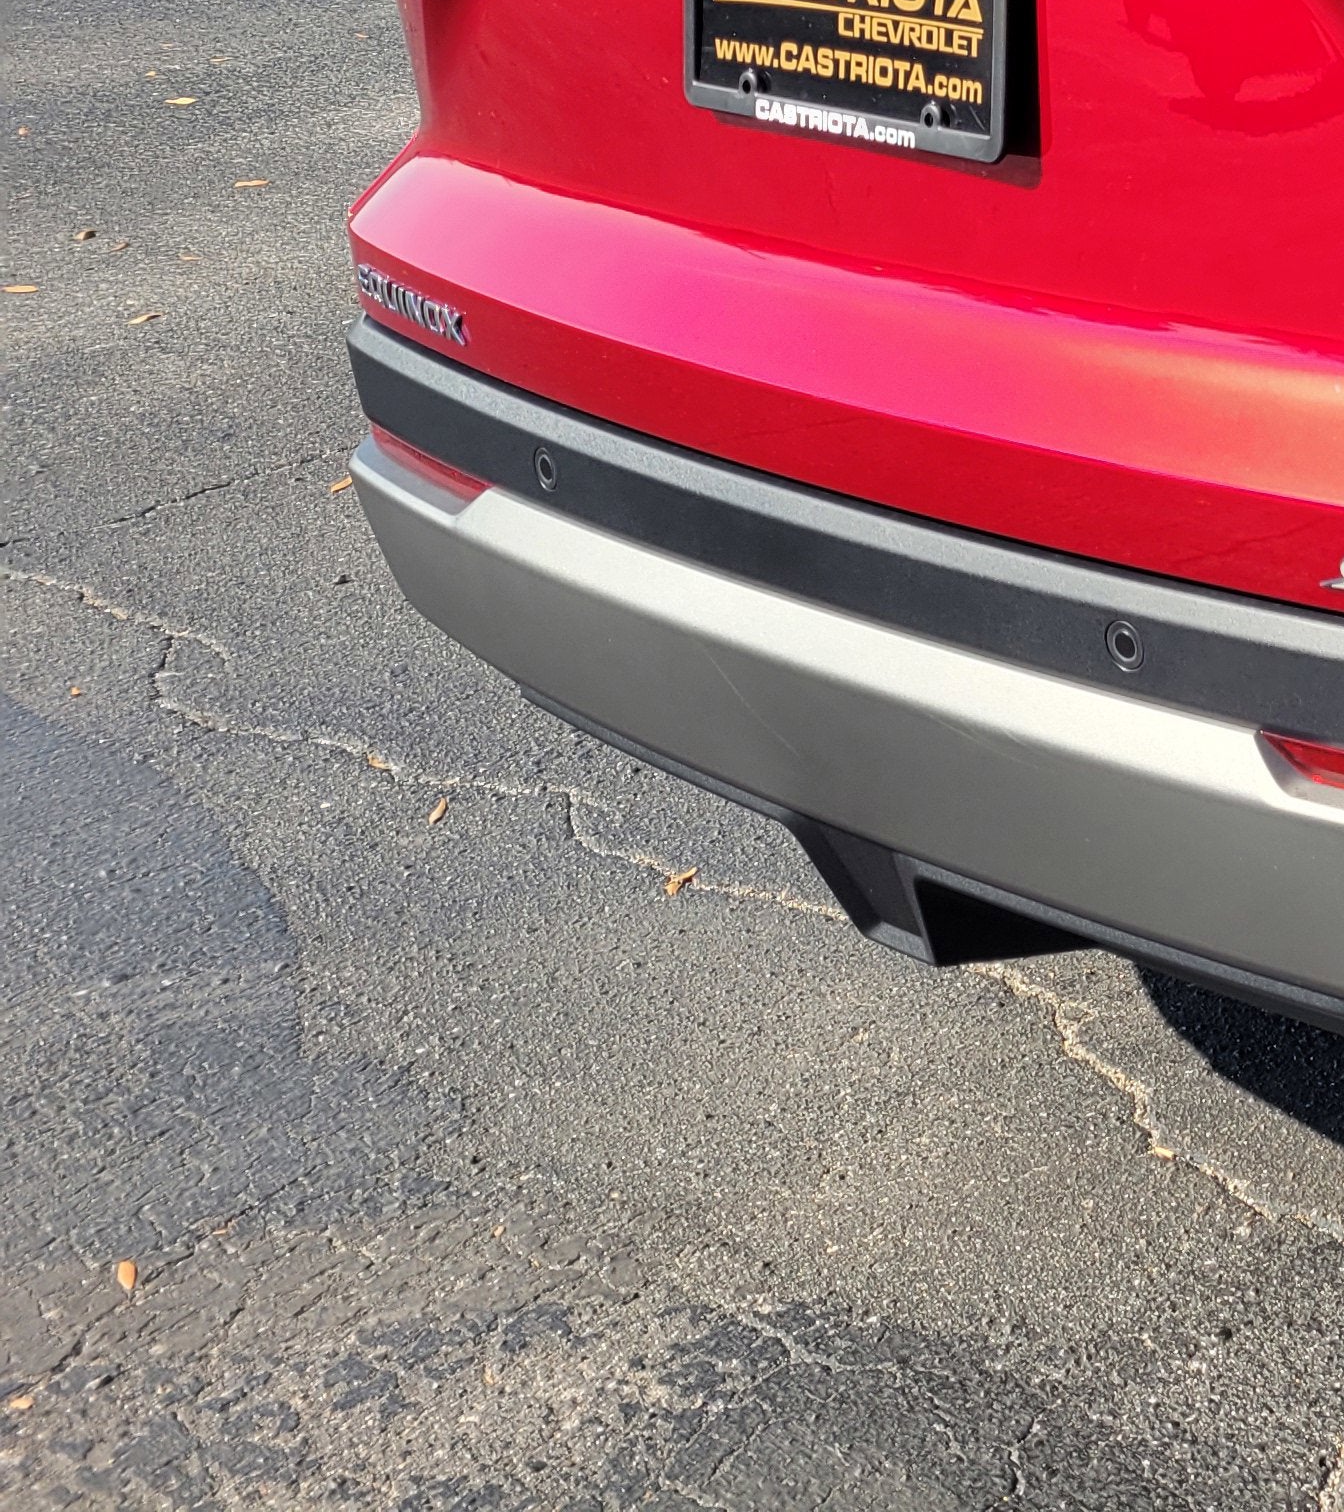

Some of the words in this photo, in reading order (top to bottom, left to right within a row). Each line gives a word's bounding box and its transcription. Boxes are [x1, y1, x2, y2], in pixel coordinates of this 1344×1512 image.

[837, 13, 984, 58] CHEVROLET
[714, 37, 983, 104] www.CASTRIOTA.com
[755, 99, 916, 149] CASTRIOTA.com
